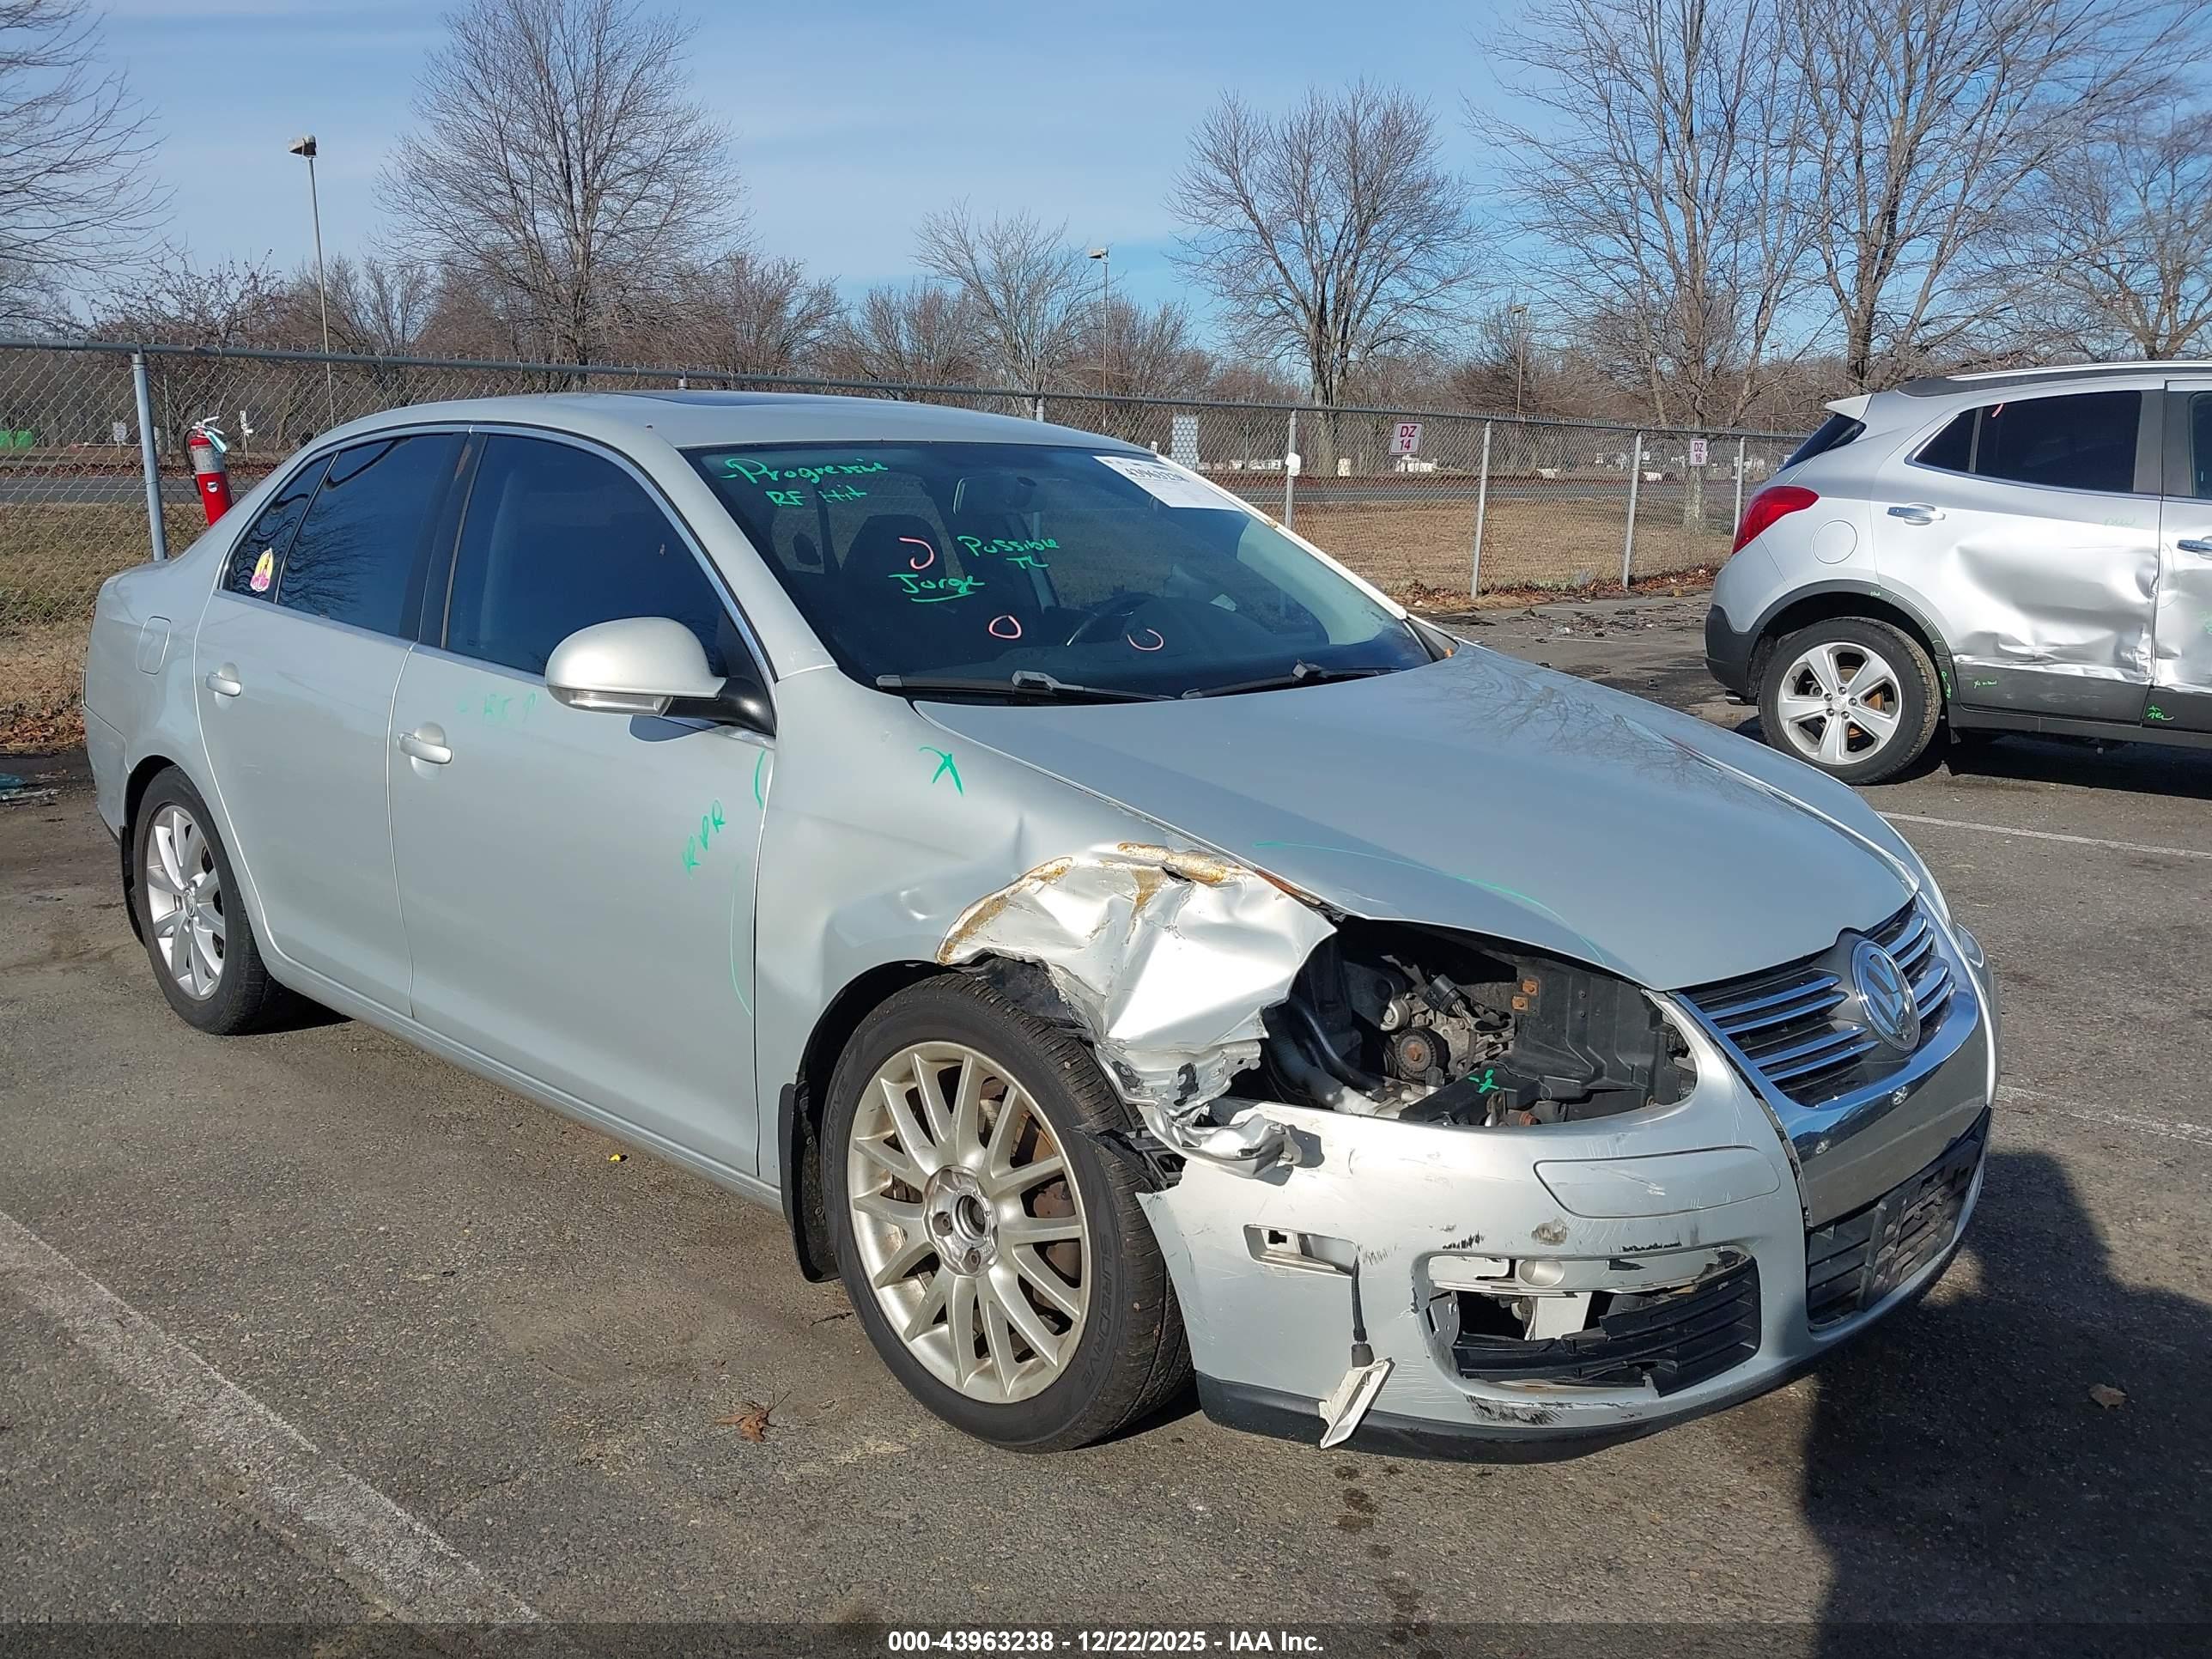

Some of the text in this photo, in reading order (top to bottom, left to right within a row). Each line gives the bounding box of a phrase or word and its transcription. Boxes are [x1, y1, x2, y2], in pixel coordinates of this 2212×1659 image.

[1400, 425, 1418, 438] DZ
[1400, 439, 1412, 451] 14
[1693, 441, 1705, 453] DZ
[1695, 453, 1703, 464] 16
[766, 490, 805, 507] RF
